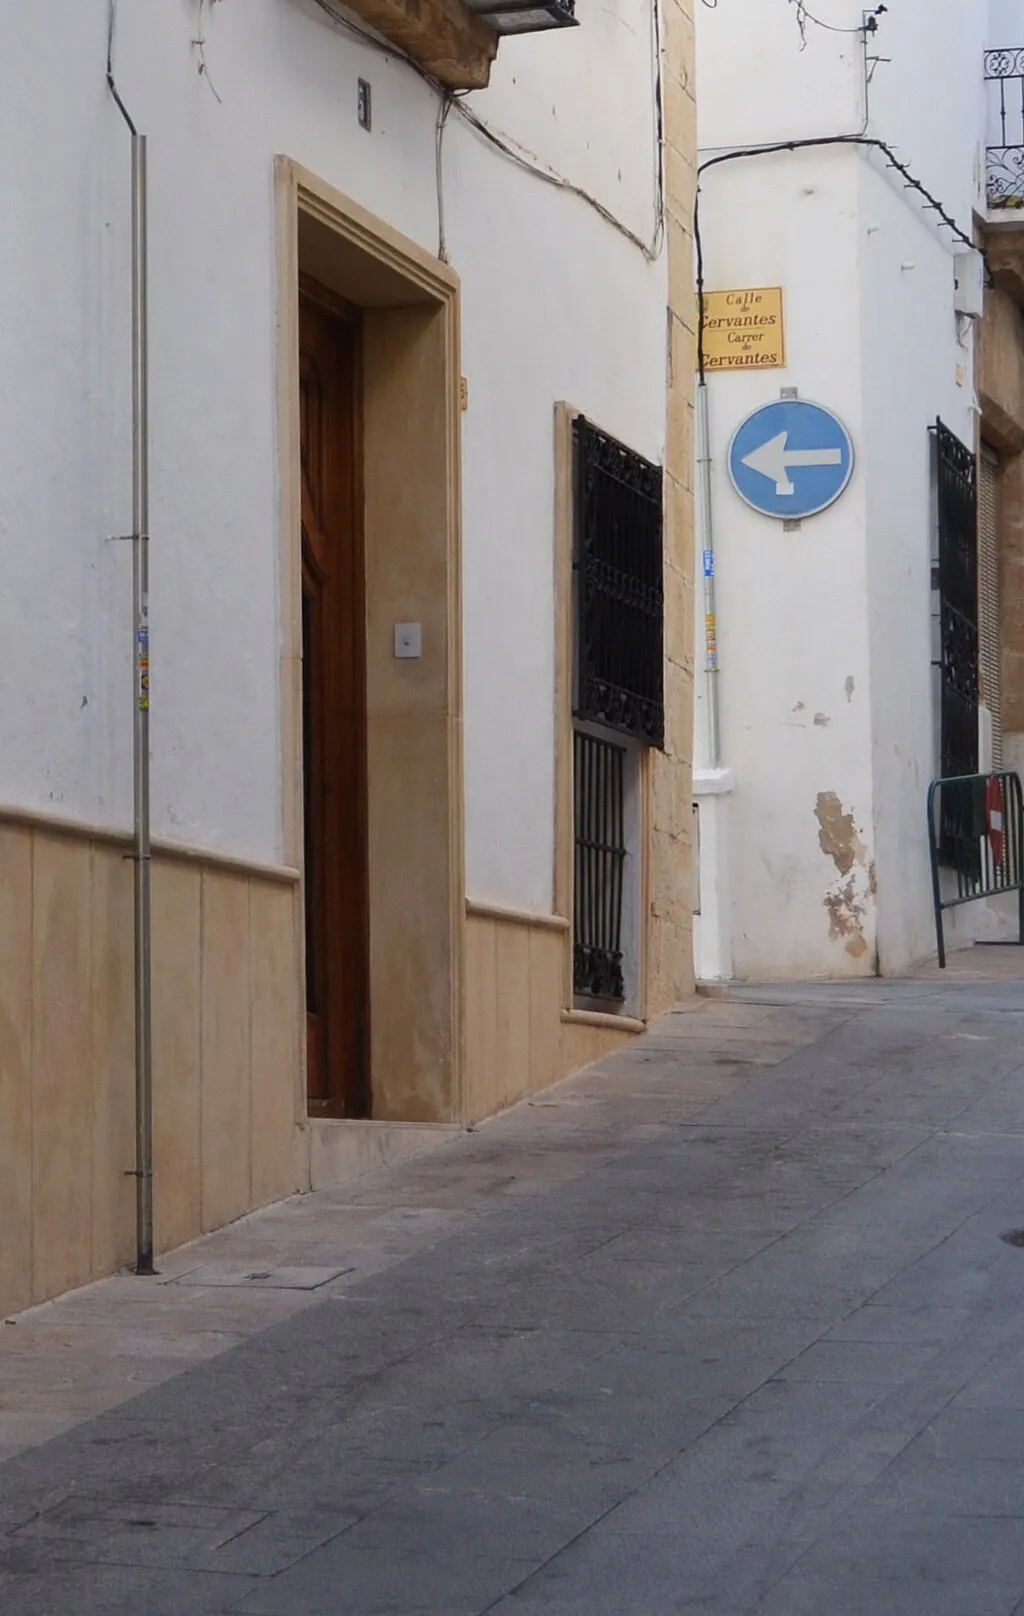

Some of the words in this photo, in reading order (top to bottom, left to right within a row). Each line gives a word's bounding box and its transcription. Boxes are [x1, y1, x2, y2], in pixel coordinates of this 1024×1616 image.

[726, 292, 762, 305] Calle
[740, 304, 750, 312] de
[727, 331, 765, 343] Carrer
[741, 343, 752, 351] de
